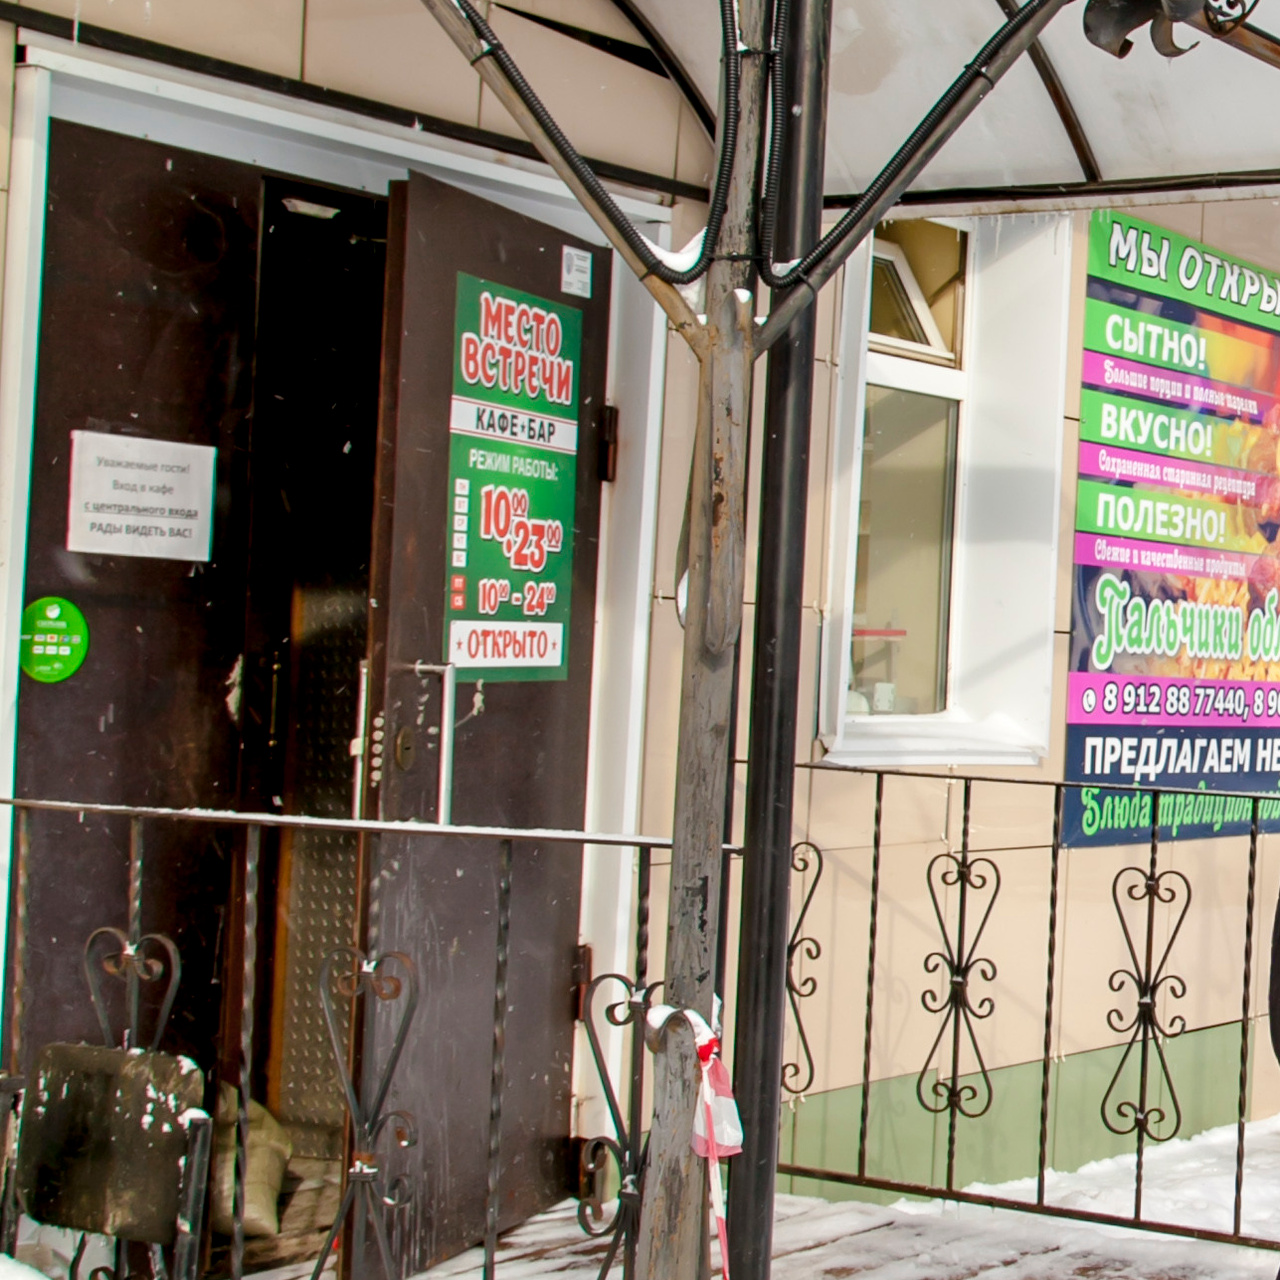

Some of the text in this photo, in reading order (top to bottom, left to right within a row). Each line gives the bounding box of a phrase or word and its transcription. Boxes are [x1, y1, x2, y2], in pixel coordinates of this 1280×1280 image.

[1108, 221, 1170, 282] МЫ
[481, 292, 562, 357] МЕСТО
[1105, 313, 1207, 371] СЫТНО!
[462, 332, 573, 405] ВСТРЕЧИ
[1103, 359, 1259, 416] Большие порции и полные тарелки
[476, 406, 556, 444] КАФЕ БАР
[1101, 402, 1213, 458] ВКУСНО!
[96, 456, 191, 474] Уважаемые гости!
[112, 479, 174, 496] Вход в кафе
[469, 448, 559, 481] РЕЖИМ РАБОТЫ:
[1099, 449, 1256, 501] Сохраненная старинная рецептура
[83, 501, 199, 519] с центрального входа
[89, 521, 193, 539] РАДЫ ВИДЕТЬ ВАС!
[1096, 492, 1226, 544] ПОЛЕЗНО!
[1094, 538, 1246, 579] Свежие и качественные продукты
[468, 628, 548, 659] ОТКРЫТО
[1092, 573, 1243, 670] Пальчики
[1103, 682, 1118, 714] 8
[1123, 682, 1161, 714] 912
[1165, 685, 1190, 715] 88
[1194, 686, 1249, 721] 77440,
[1253, 688, 1264, 717] 8
[1084, 736, 1251, 782] ПРЕДЛАГАЕМ
[1081, 781, 1152, 836] Блюда
